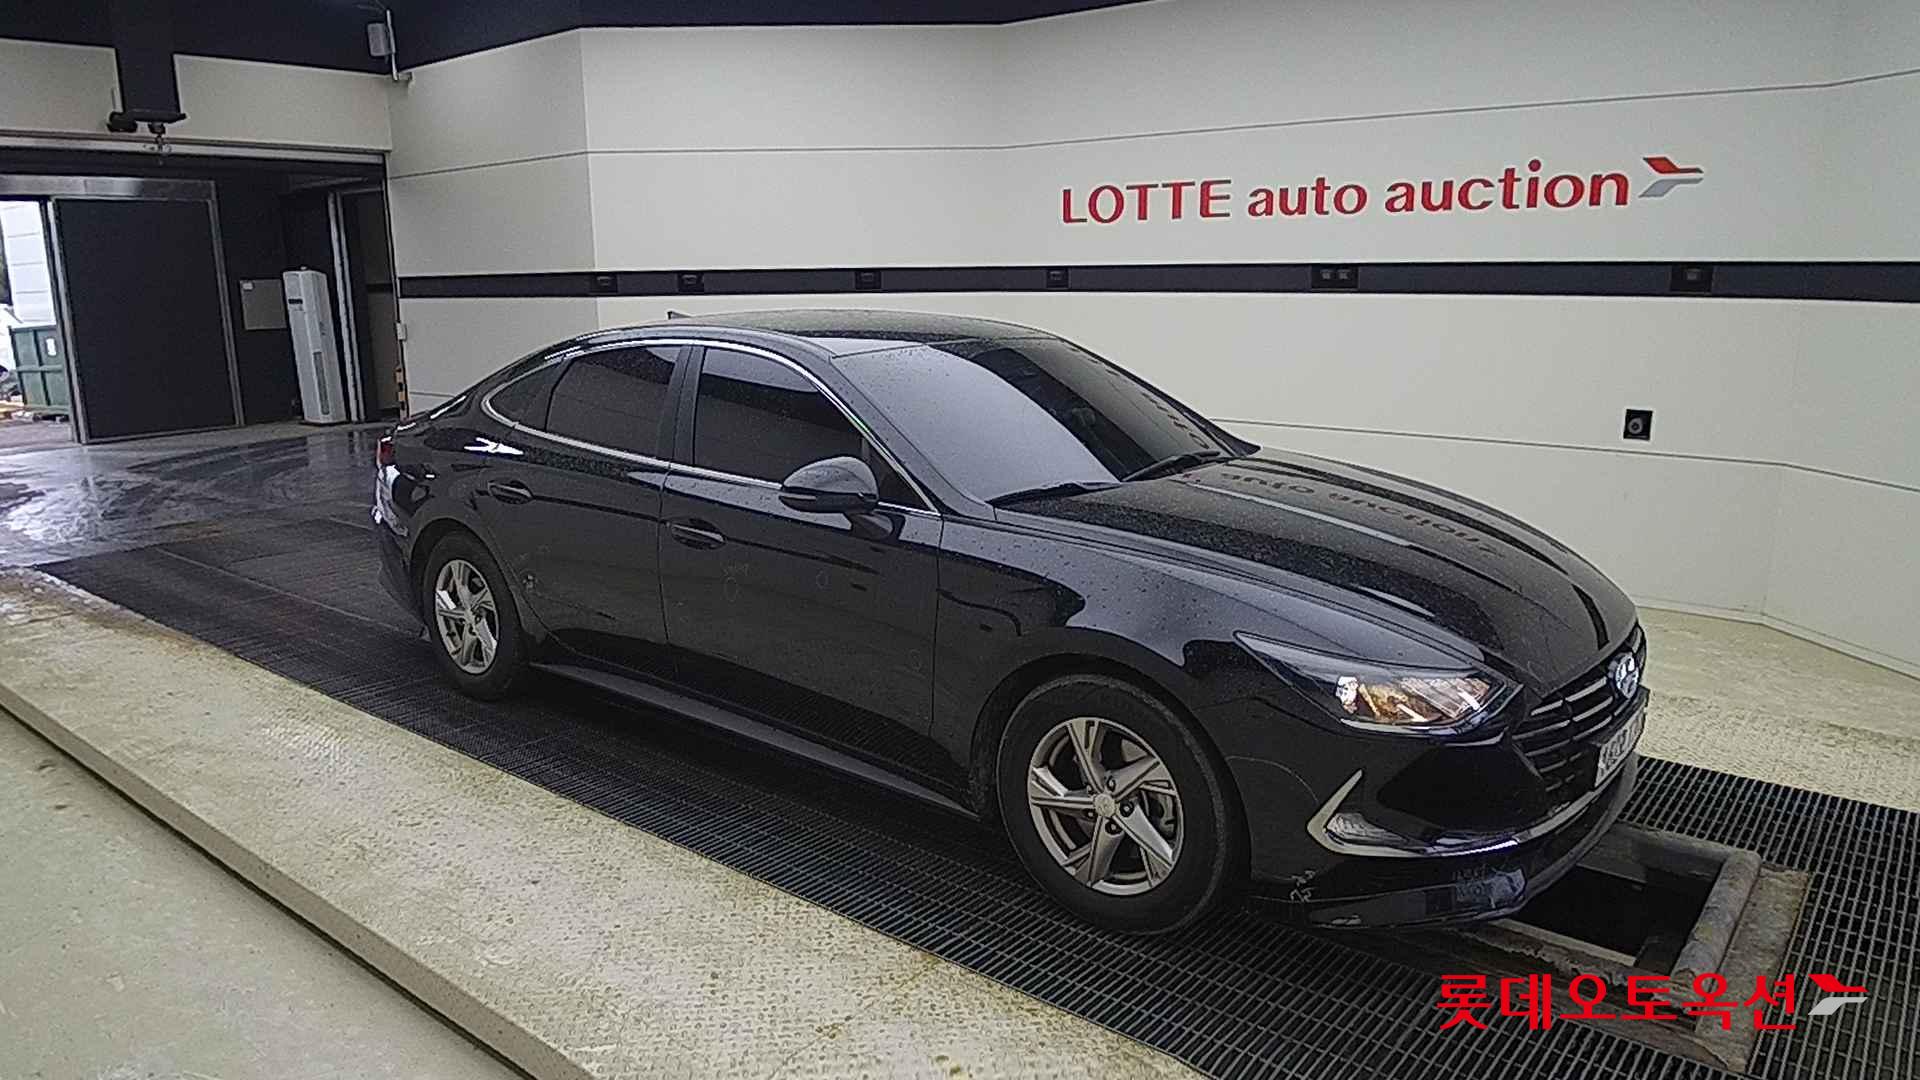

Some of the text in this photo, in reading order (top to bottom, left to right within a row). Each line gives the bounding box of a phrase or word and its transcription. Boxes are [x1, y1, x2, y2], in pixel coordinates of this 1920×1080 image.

[1062, 159, 1630, 223] LOTTE auto auction
